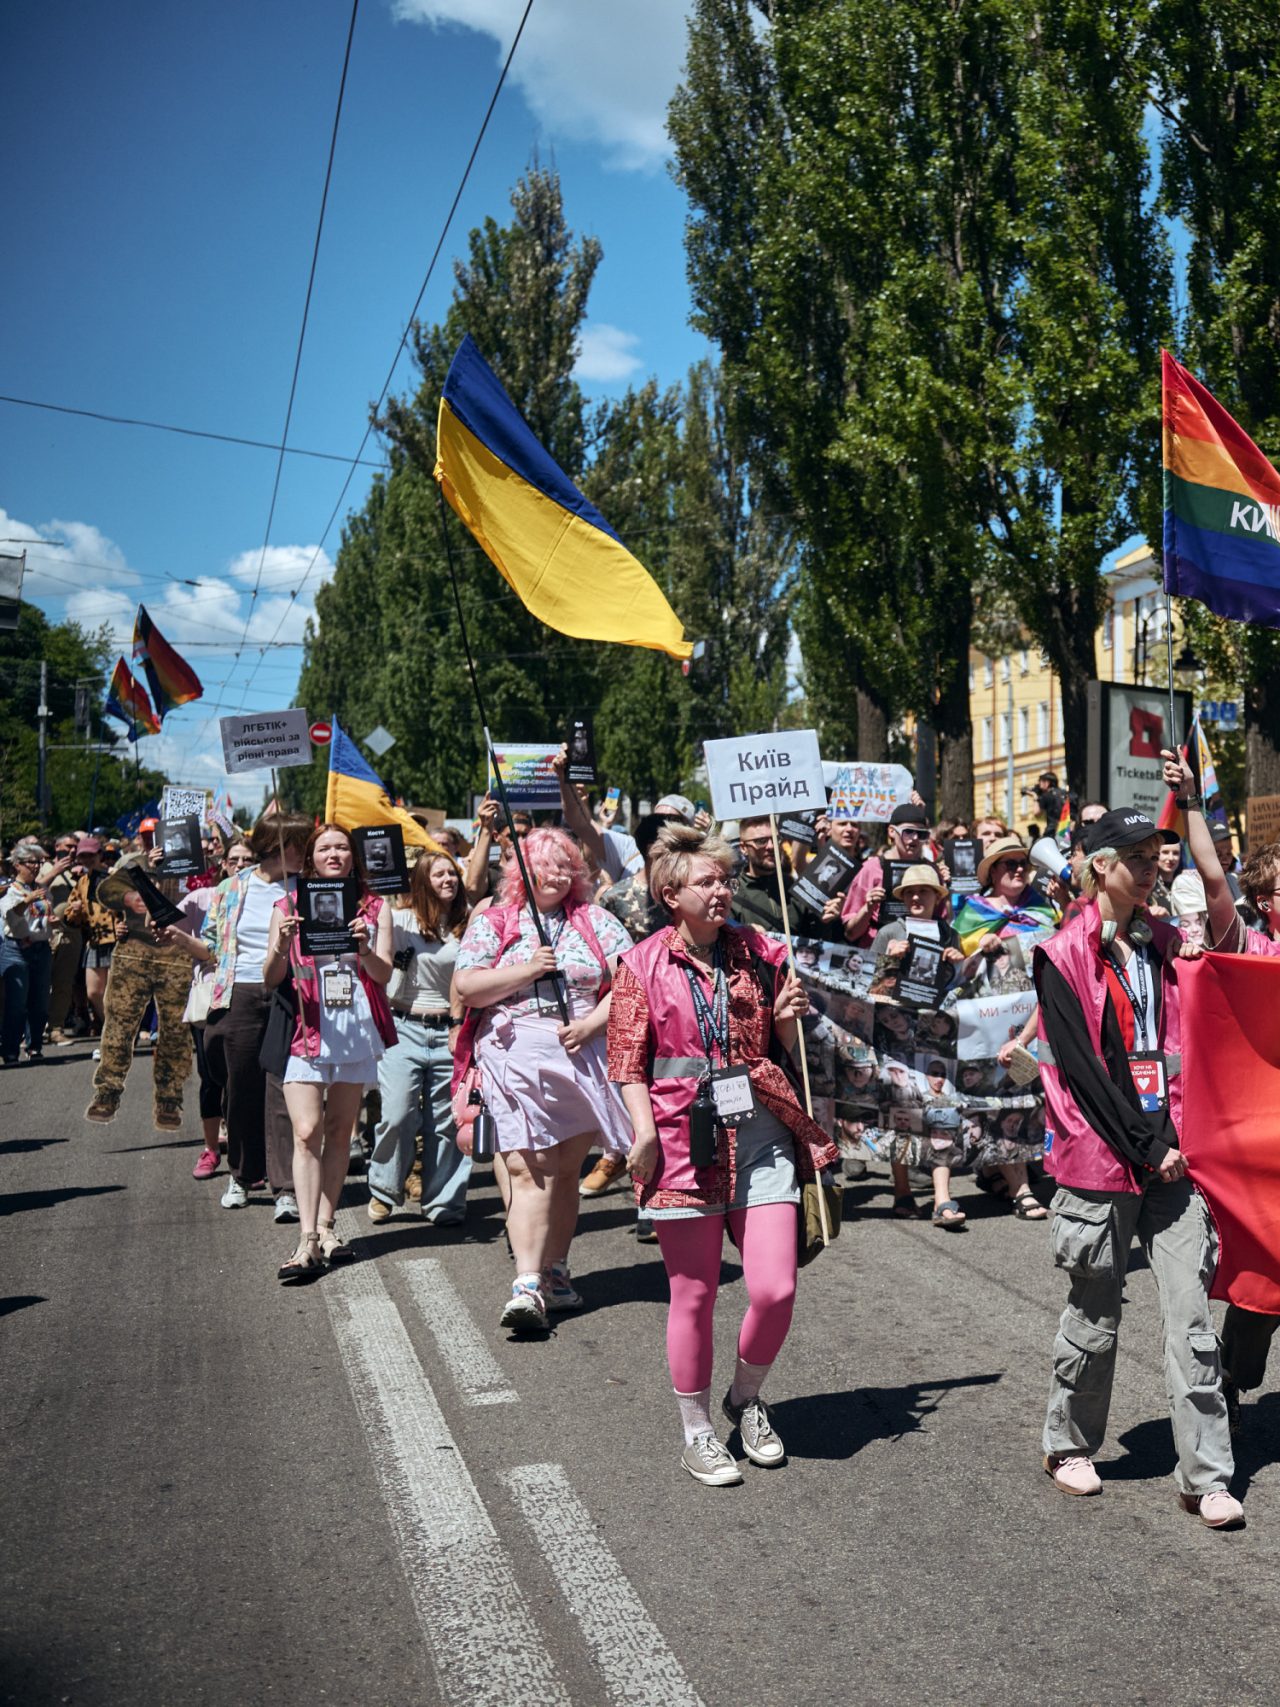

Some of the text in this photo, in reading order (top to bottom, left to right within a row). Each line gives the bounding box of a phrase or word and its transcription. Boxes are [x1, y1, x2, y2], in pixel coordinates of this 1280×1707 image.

[243, 721, 287, 733] ЛГБТІК+
[233, 734, 286, 747] військові
[238, 747, 300, 762] рівні права
[738, 749, 792, 772] Київ
[836, 767, 892, 787] MAKE
[1116, 766, 1164, 781] TicketsB
[729, 776, 810, 805] Прайд
[979, 1007, 999, 1019] МИ
